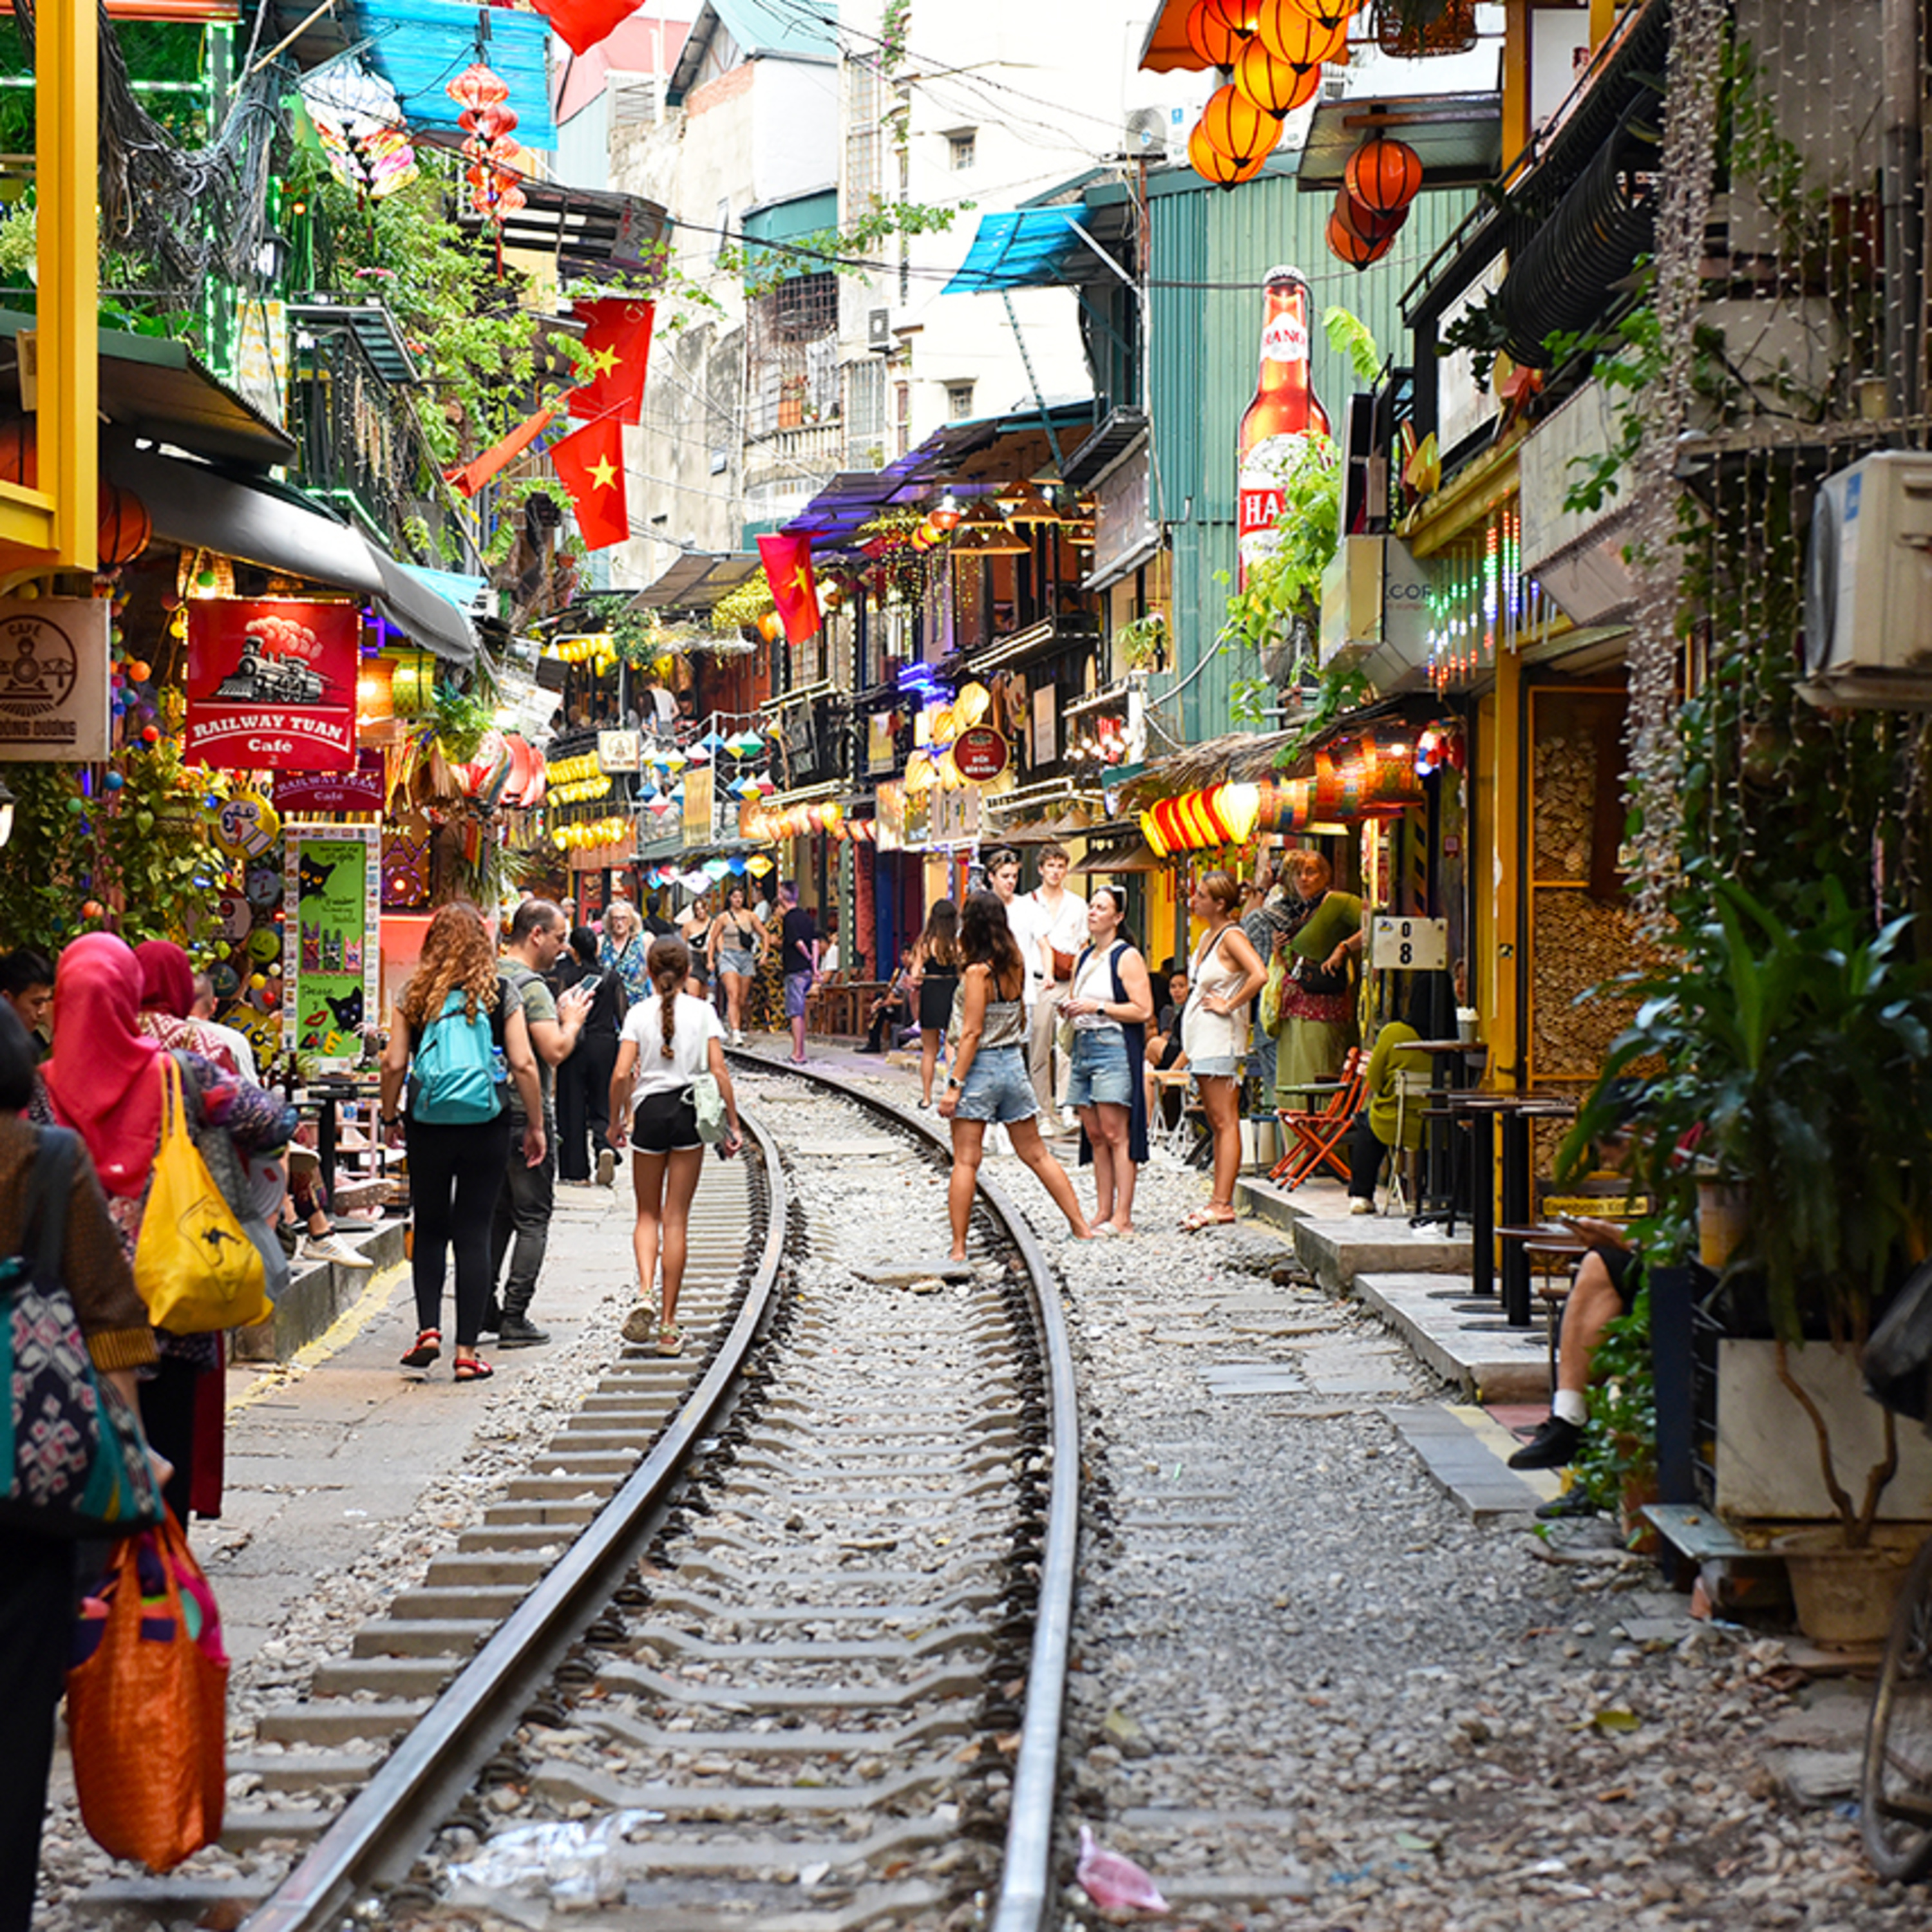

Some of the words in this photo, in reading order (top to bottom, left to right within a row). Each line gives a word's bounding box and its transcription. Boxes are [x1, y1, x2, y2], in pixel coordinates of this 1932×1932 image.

[193, 714, 285, 739] RAILWAY
[289, 715, 343, 740] TUAN
[247, 739, 293, 752] Café
[278, 775, 339, 793] RAILWAY
[1401, 922, 1411, 938] 0
[1400, 943, 1412, 964] 8
